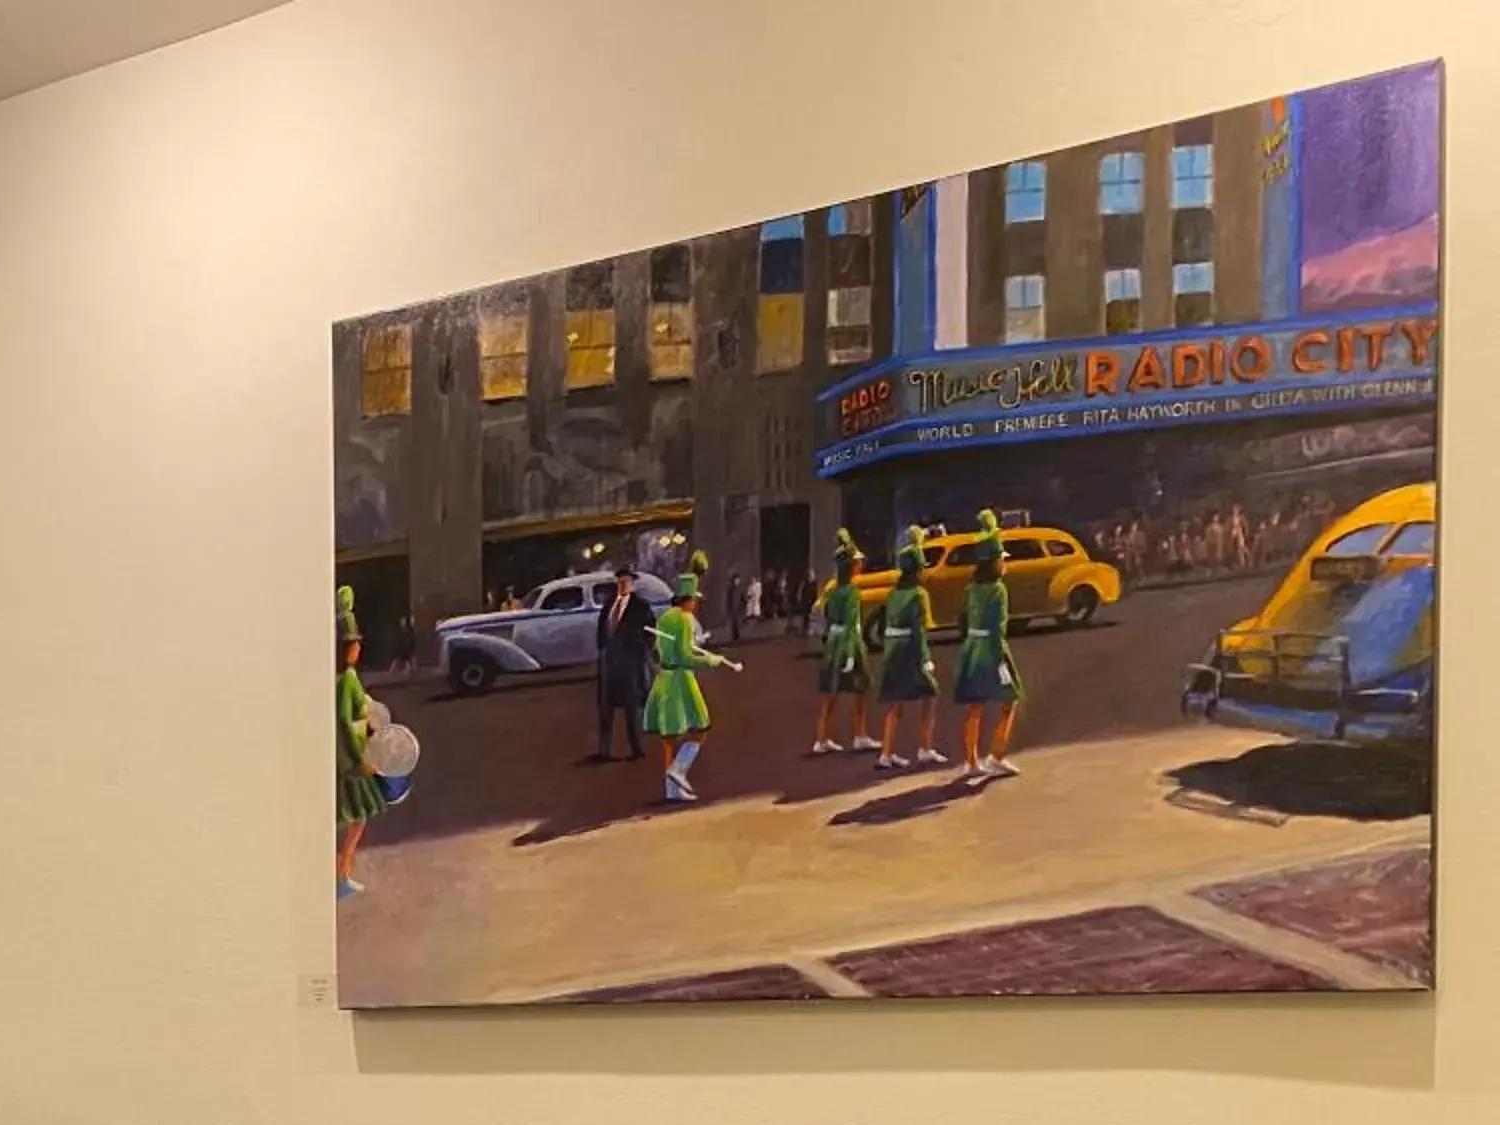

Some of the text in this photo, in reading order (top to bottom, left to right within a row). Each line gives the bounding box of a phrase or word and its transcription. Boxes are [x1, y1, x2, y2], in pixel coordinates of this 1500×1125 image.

[909, 353, 1076, 413] Music Hall
[1085, 317, 1438, 397] RADIO CITY
[840, 380, 890, 416] RADIO
[916, 423, 975, 442] WORLD
[995, 412, 1068, 433] PREMIERE
[1083, 408, 1120, 425] RITA
[1127, 400, 1217, 421] HAYWORTH
[1312, 383, 1356, 402] WITH
